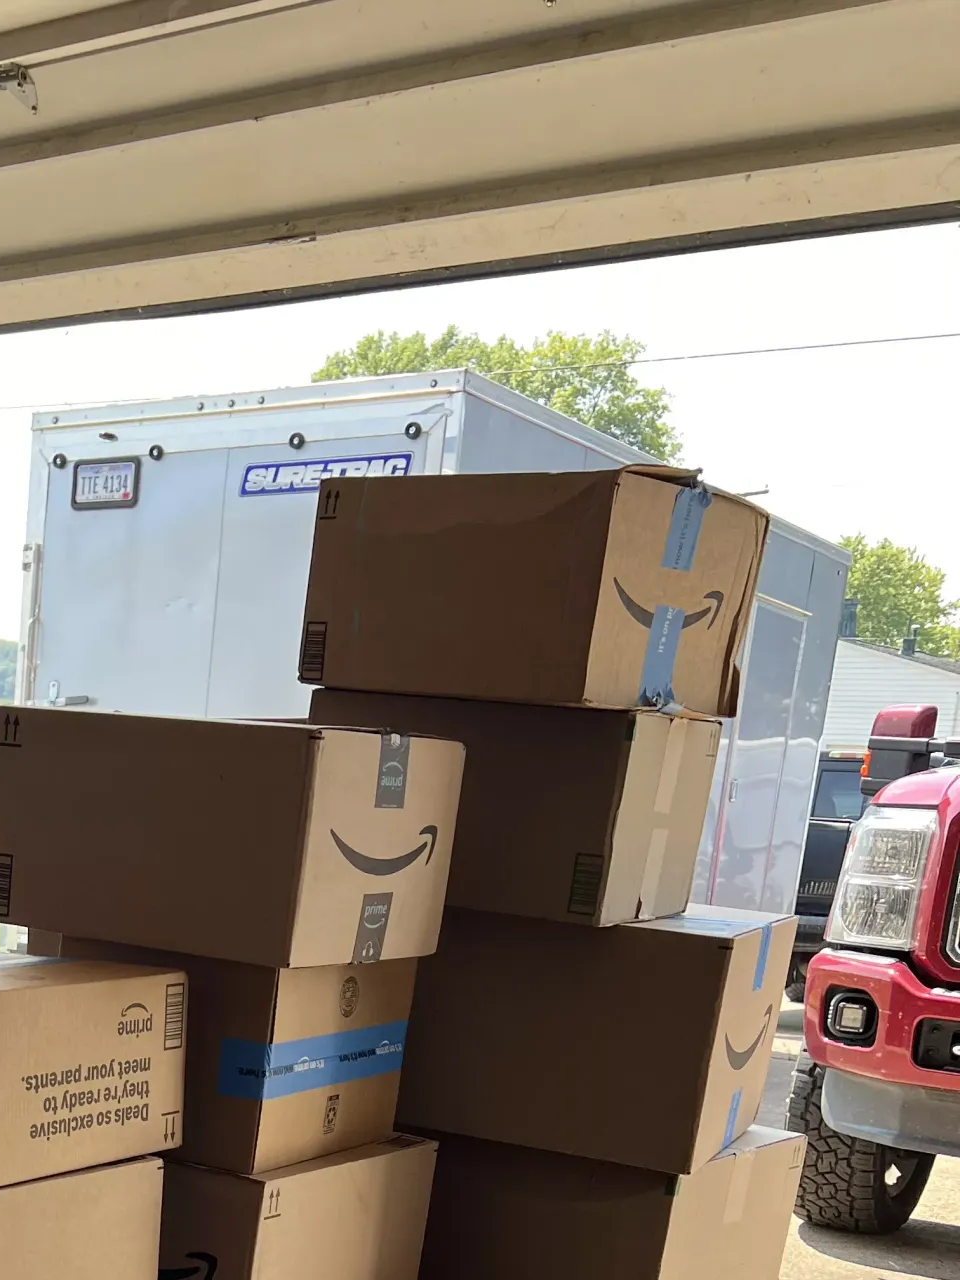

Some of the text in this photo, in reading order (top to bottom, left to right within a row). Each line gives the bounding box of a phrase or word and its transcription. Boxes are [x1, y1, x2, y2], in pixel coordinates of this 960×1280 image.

[103, 474, 128, 493] 4134
[381, 773, 404, 790] prime
[363, 901, 388, 918] prime
[117, 1013, 153, 1038] prime
[21, 1057, 151, 1094] meet your parents.
[43, 1080, 150, 1115] they're ready to
[29, 1103, 149, 1142] Deals so exclusive
